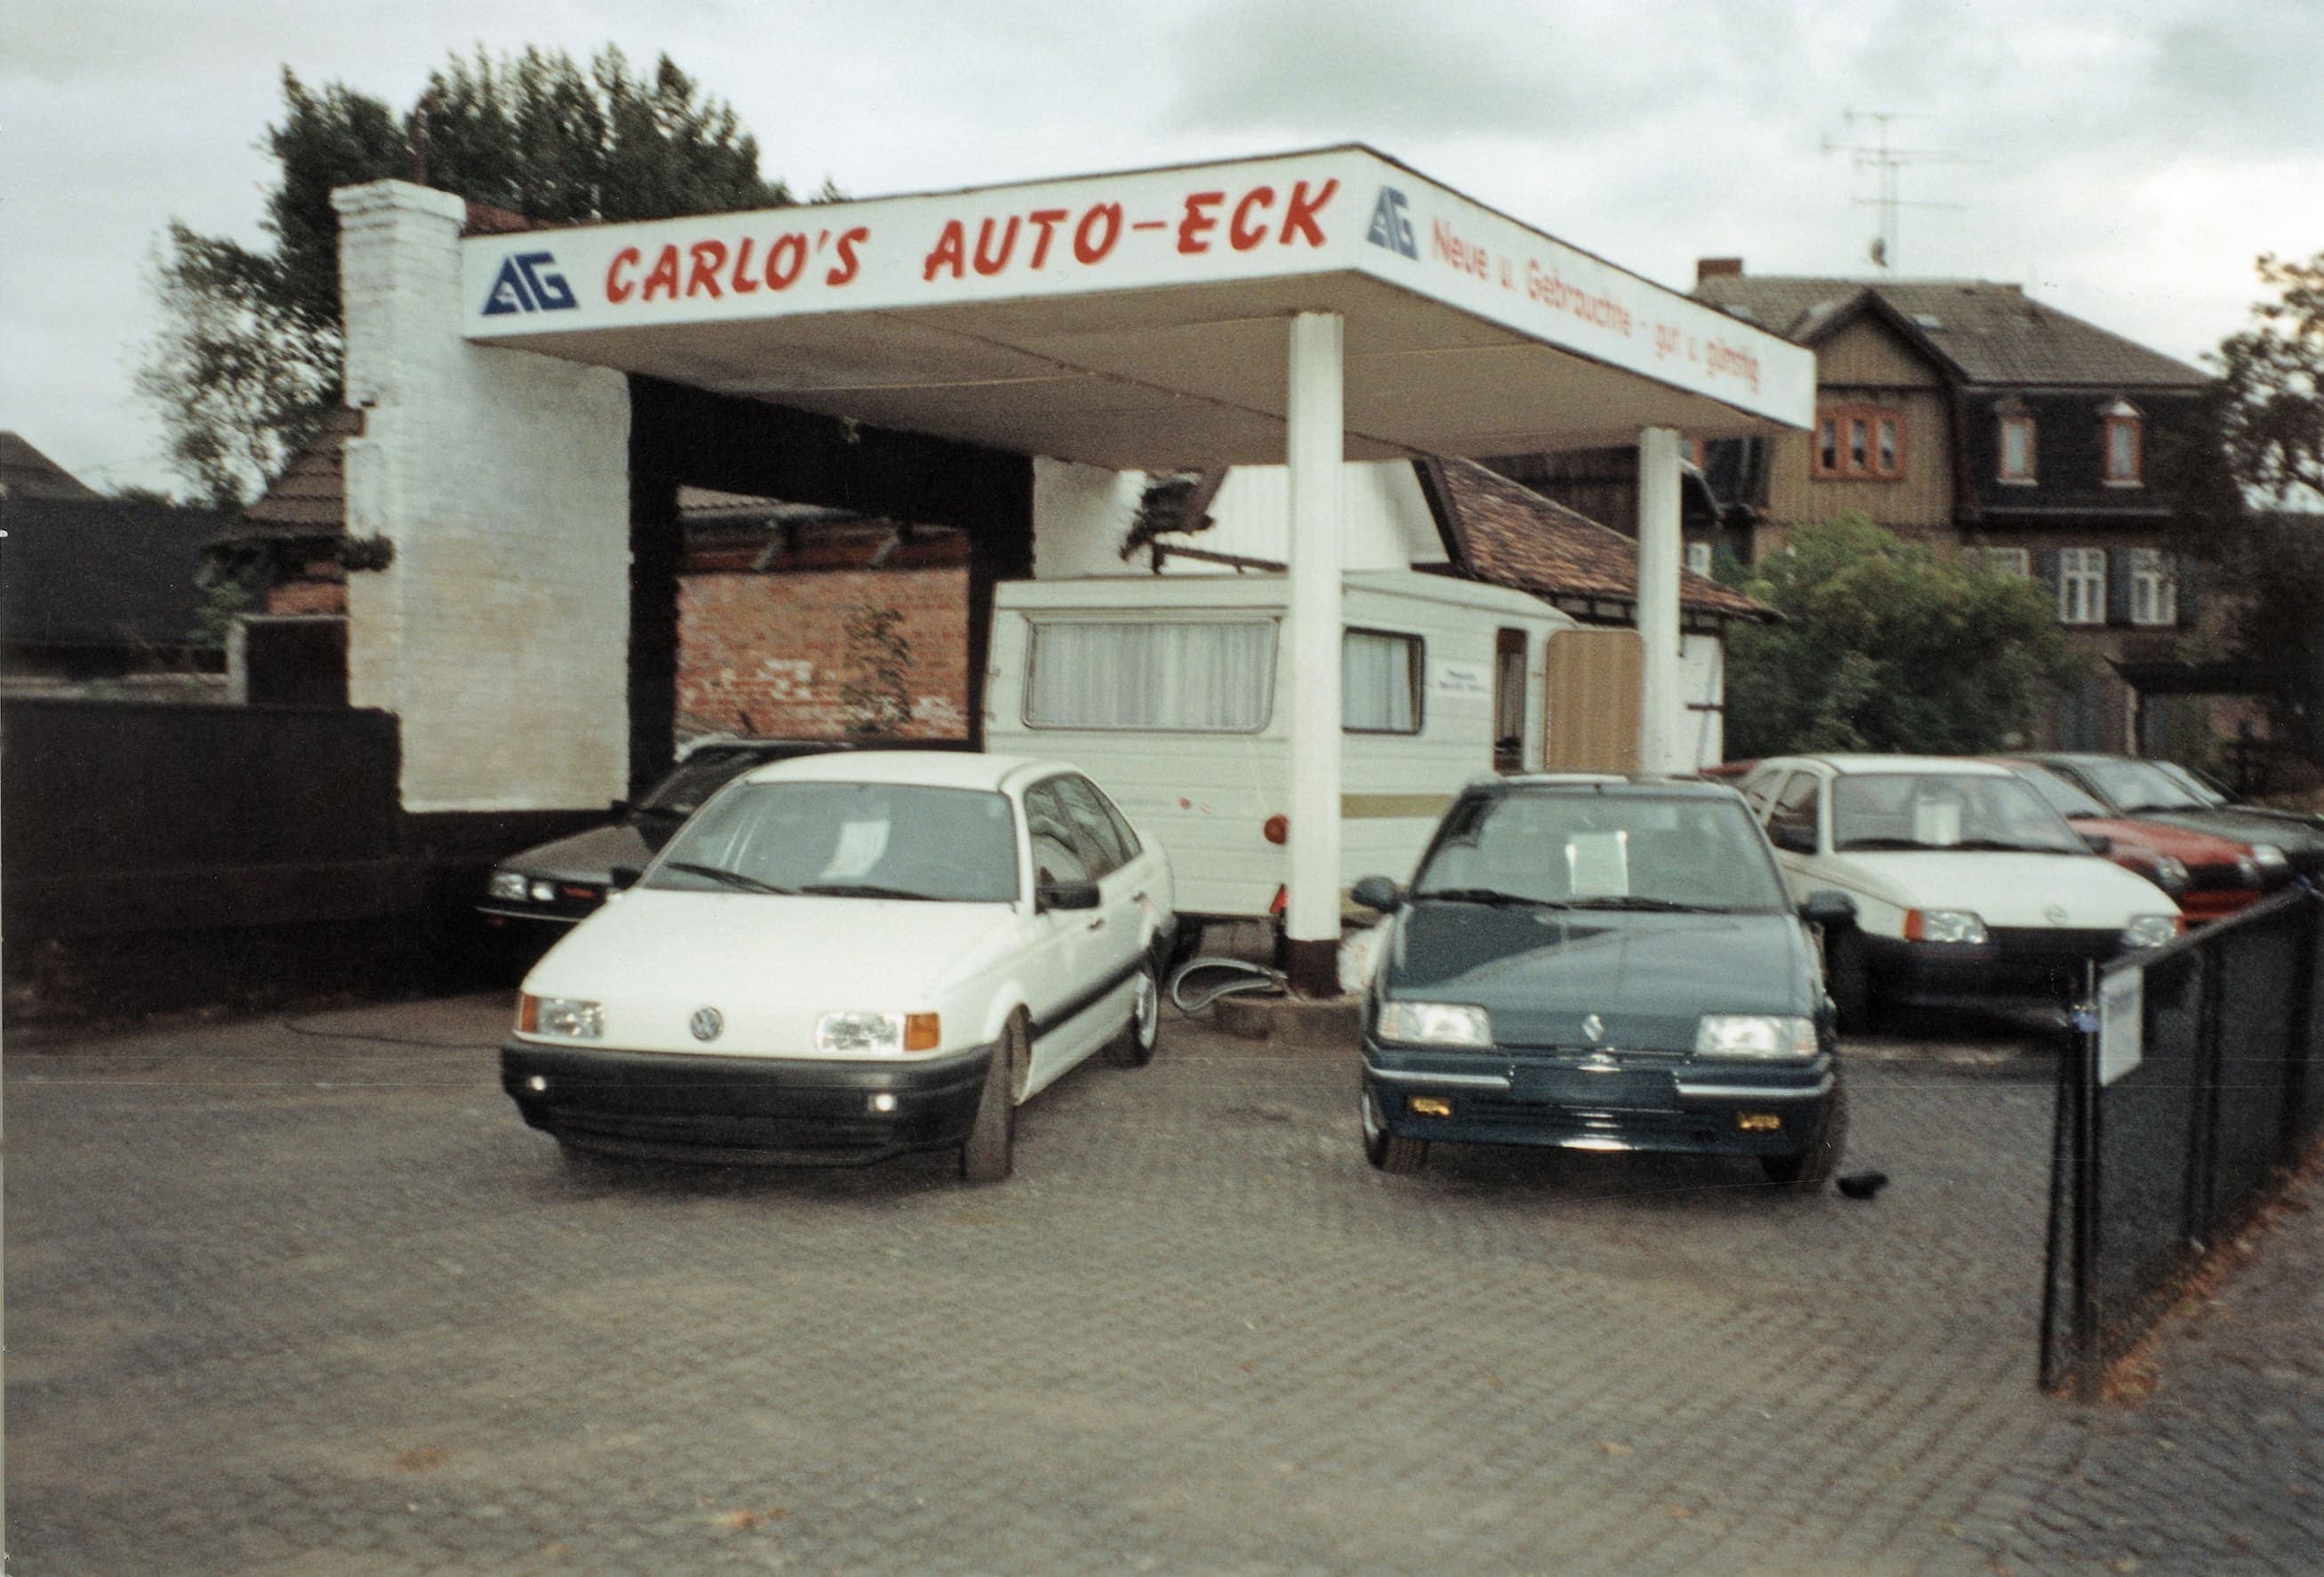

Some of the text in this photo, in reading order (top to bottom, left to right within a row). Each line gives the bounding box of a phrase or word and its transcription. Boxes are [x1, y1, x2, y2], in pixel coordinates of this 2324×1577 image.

[605, 179, 1339, 303] CARLO'S AUTO-ECK
[1430, 217, 1489, 280] Neue
[1499, 259, 1516, 292] u.
[1525, 258, 1633, 337] Gebrauchte
[1653, 320, 1681, 361] gut
